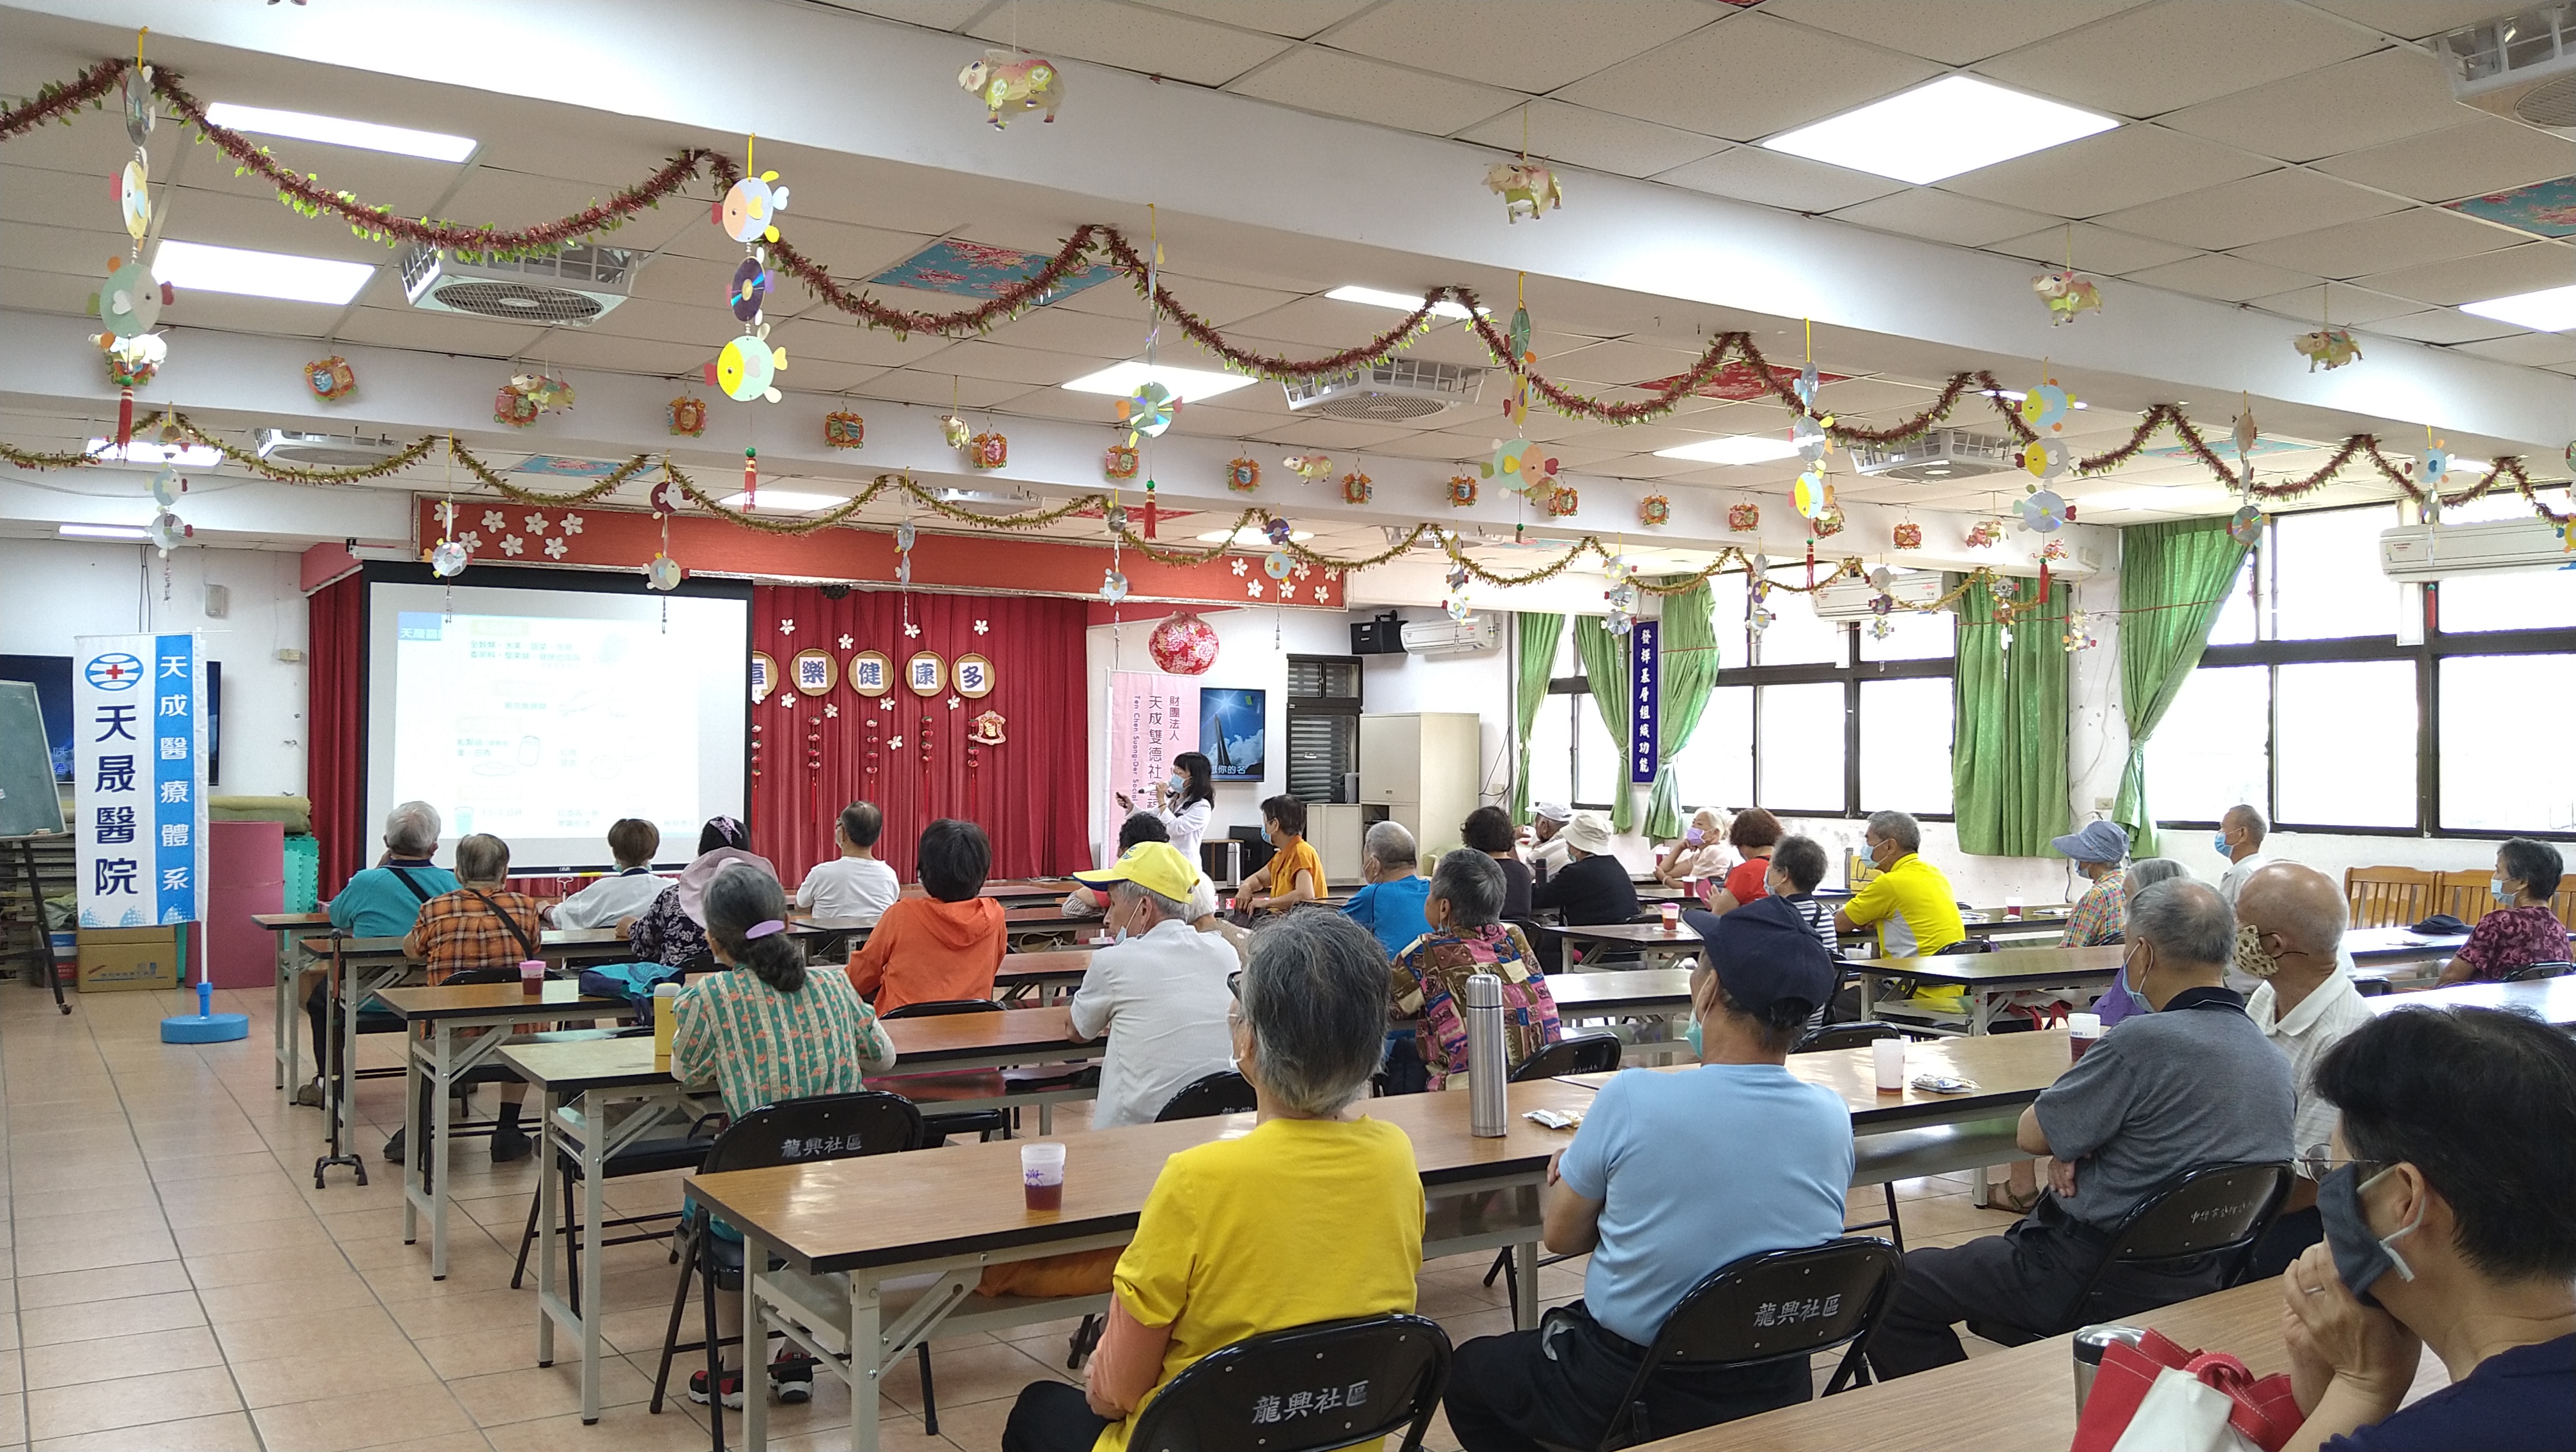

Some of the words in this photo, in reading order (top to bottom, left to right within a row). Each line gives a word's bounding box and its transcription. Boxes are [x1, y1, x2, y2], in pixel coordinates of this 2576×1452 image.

[1169, 696, 1180, 741] 財團法人
[1639, 629, 1652, 773] 發揮基層組織功能
[159, 656, 189, 891] 天成醫療體系
[95, 704, 138, 895] 天晟醫院
[781, 1134, 862, 1157] 龍興社區
[1753, 1293, 1841, 1327] 龍興社區
[1252, 1380, 1369, 1424] 龍興社區
